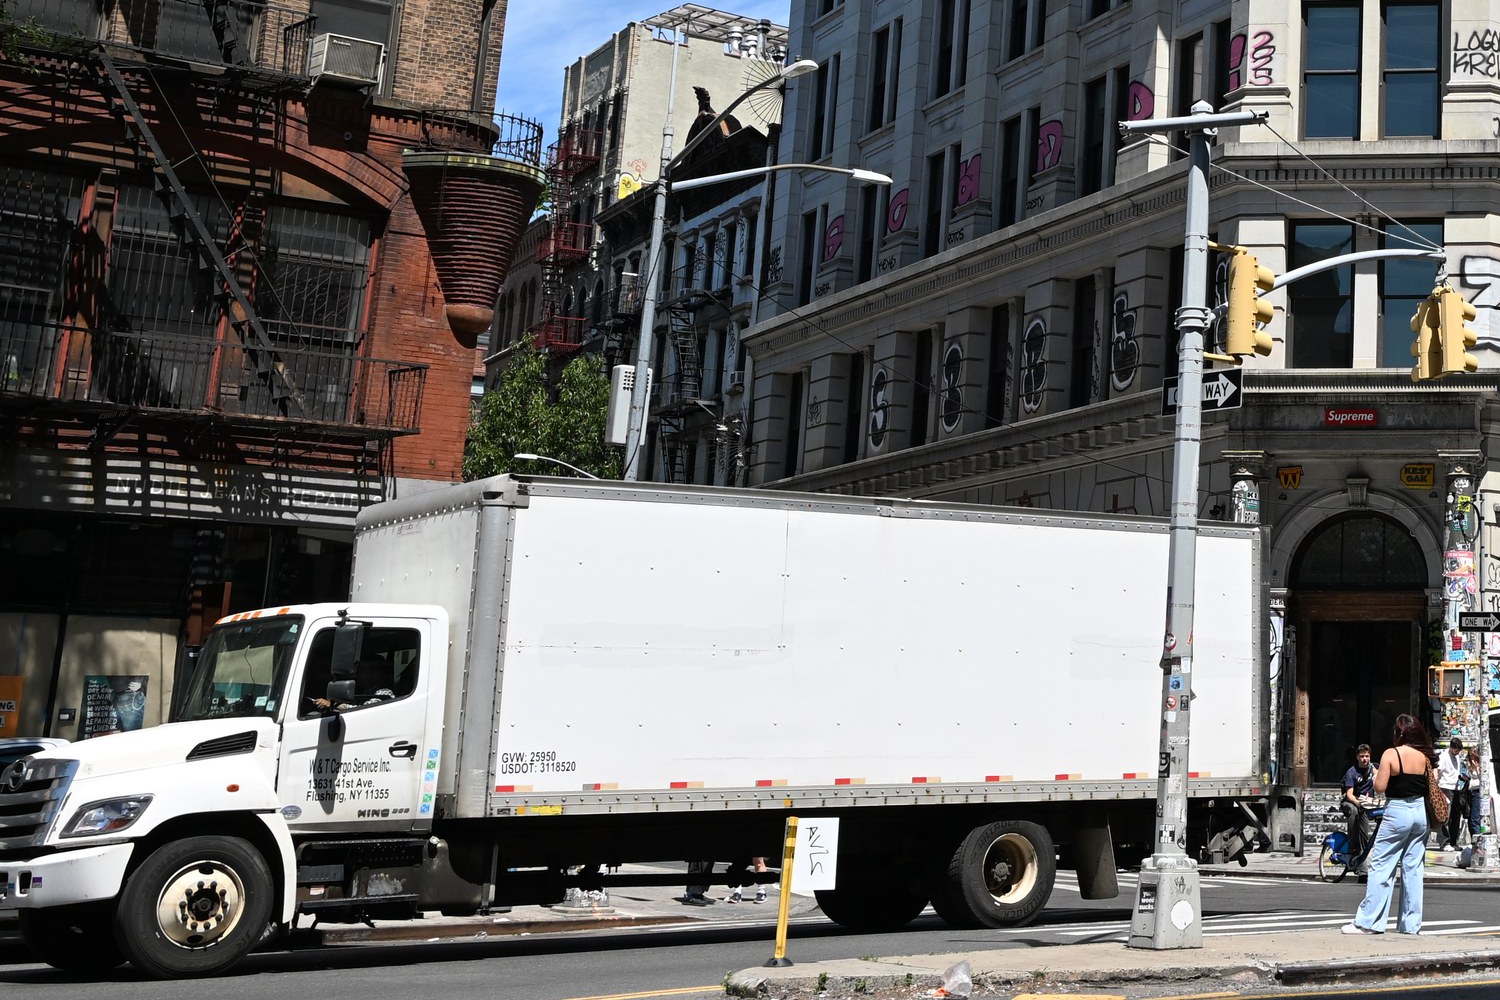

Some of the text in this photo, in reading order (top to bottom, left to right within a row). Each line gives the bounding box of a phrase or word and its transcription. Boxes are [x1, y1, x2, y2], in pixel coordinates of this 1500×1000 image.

[1205, 382, 1229, 399] WAY
[1328, 410, 1374, 422] Supreme
[1464, 618, 1497, 626] ONE WAY
[501, 751, 556, 763] GVW: 25950
[309, 757, 392, 778] W & T Cargo Service Inc.
[501, 761, 576, 774] USDOT: 3118520
[308, 777, 375, 790] 13631 41st Ave.
[306, 788, 390, 804] Flushing, NY 11355
